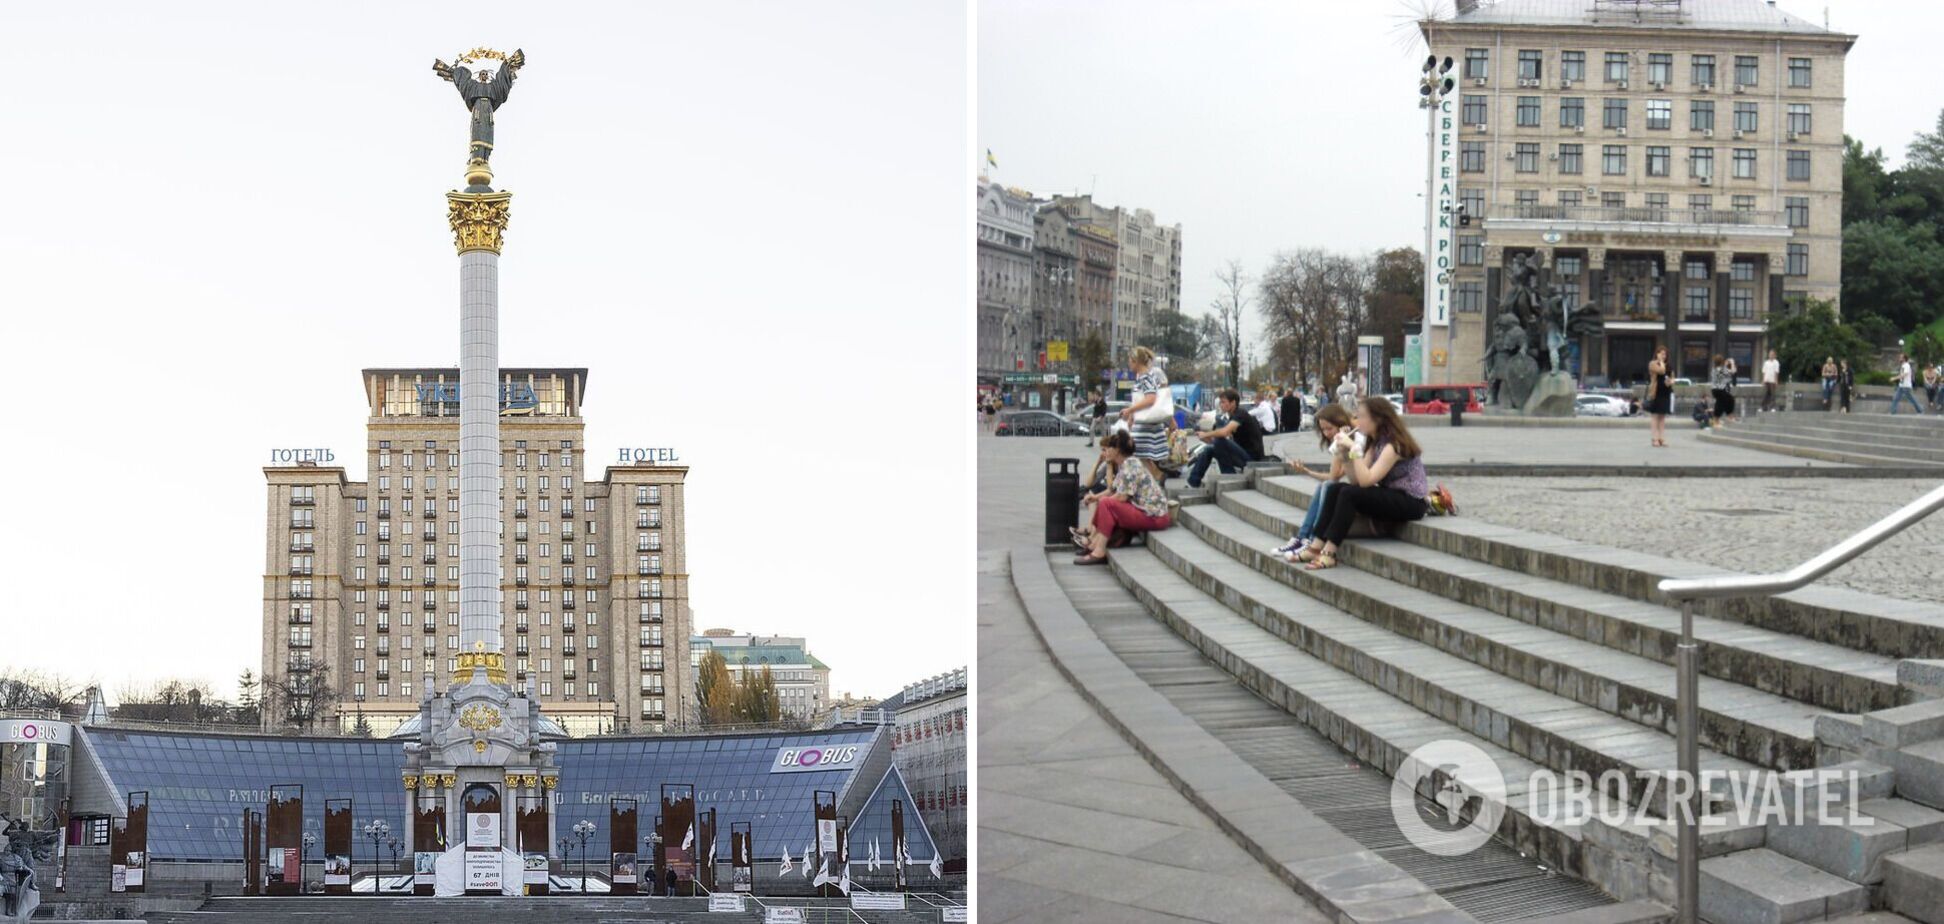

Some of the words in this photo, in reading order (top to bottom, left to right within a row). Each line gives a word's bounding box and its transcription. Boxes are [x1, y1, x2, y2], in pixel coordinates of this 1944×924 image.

[271, 448, 335, 463] ГОТЕЛЬ
[618, 447, 680, 462] HOTEL
[11, 724, 58, 740] GLOBUS
[780, 746, 858, 767] GLOBUS
